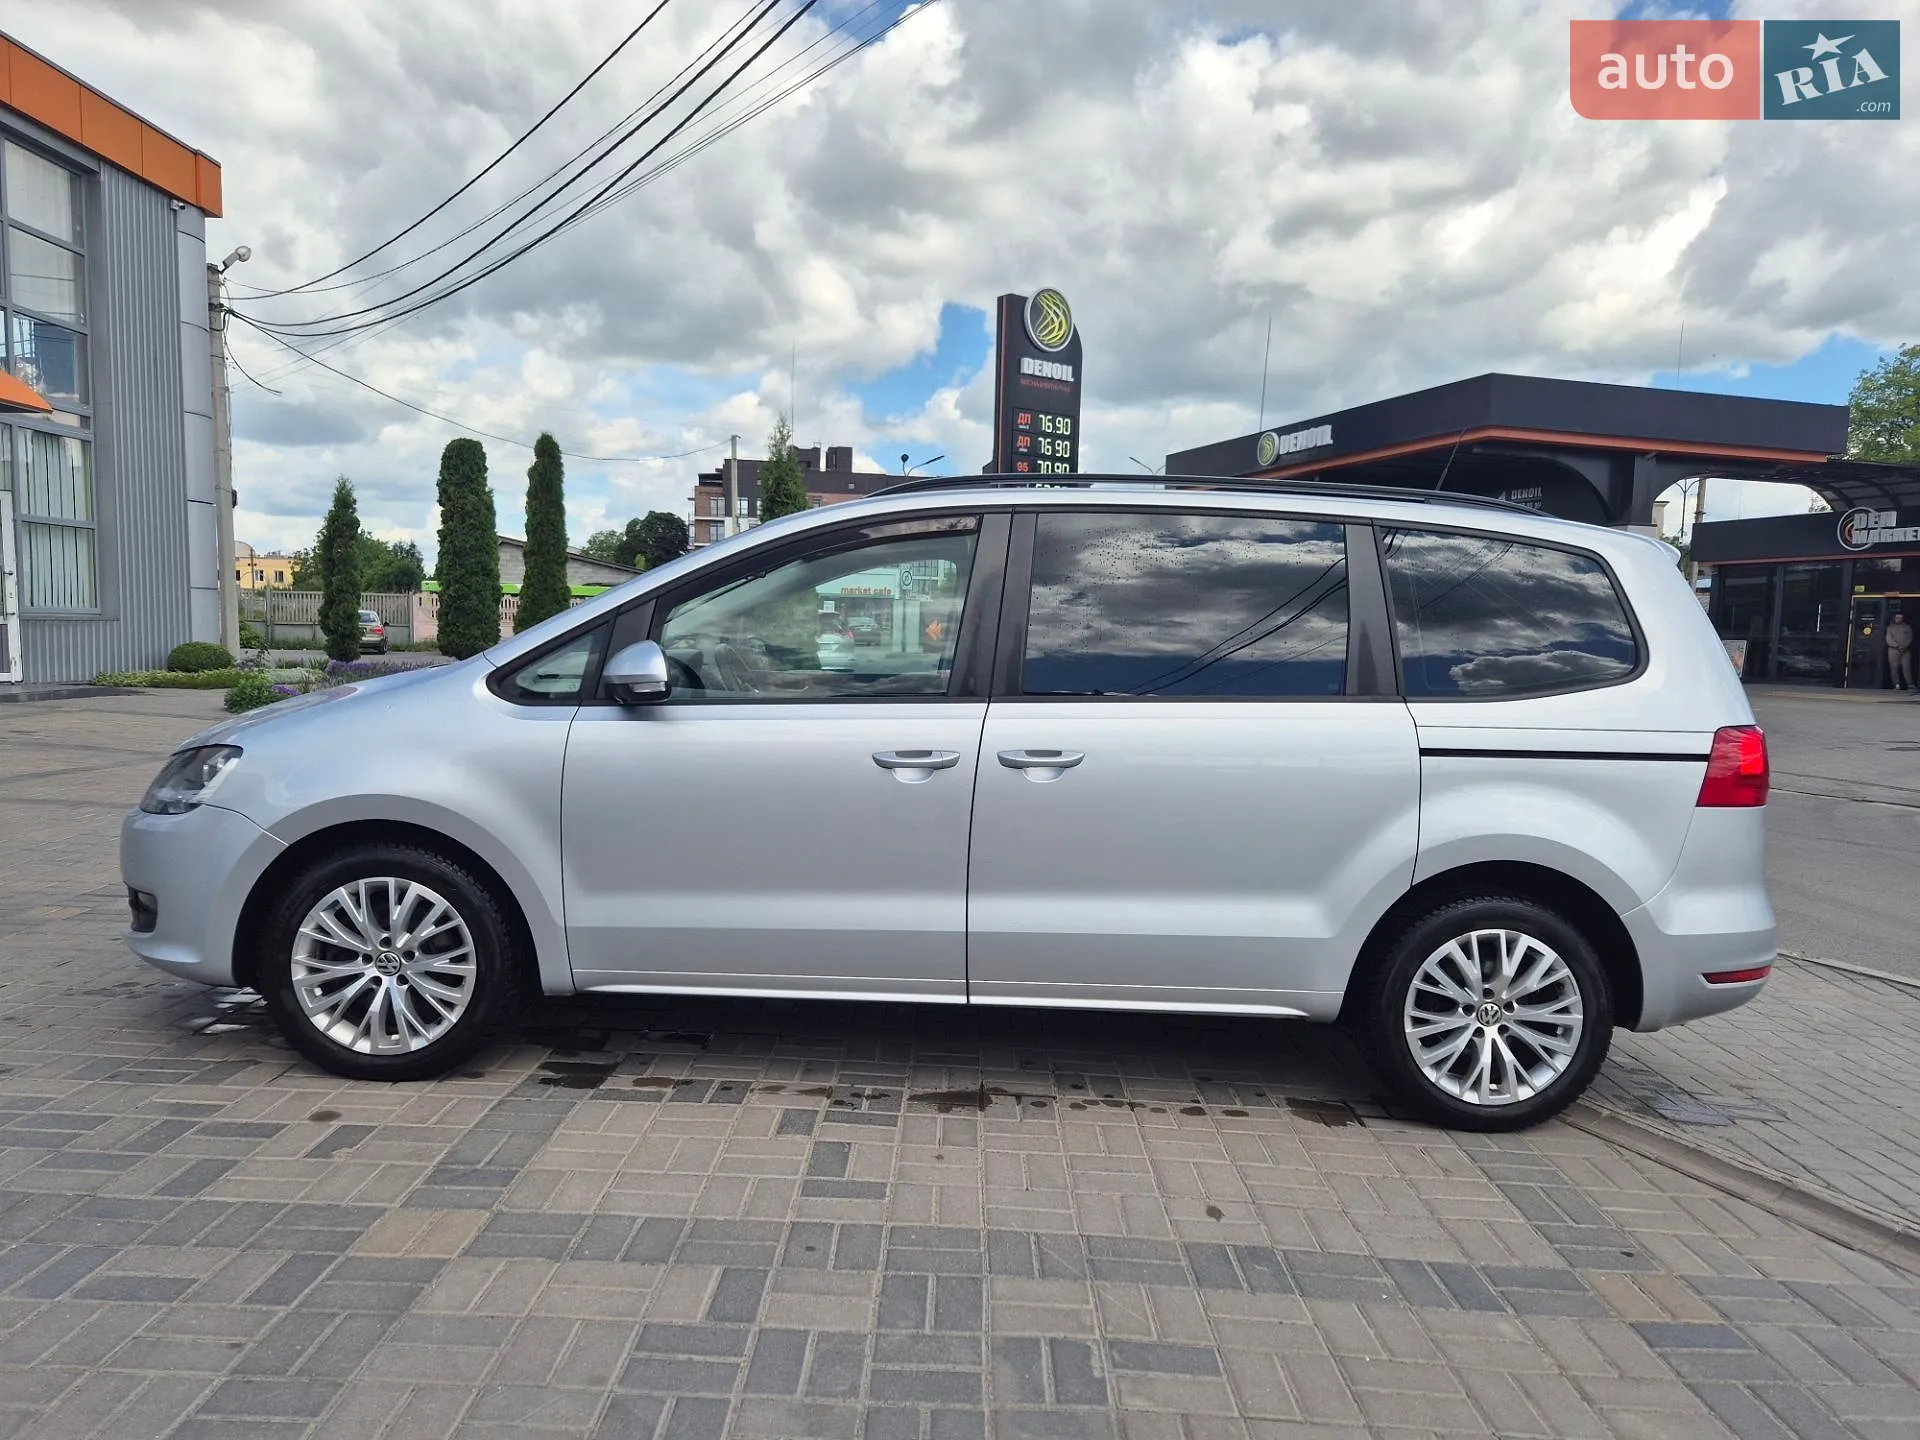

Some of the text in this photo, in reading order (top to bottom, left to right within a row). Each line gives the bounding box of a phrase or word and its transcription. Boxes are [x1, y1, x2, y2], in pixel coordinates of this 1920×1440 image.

[1020, 357, 1074, 382] DENOIL
[1038, 414, 1071, 435] 76.90
[1851, 526, 1920, 545] MARKE
[841, 586, 892, 596] market cafe
